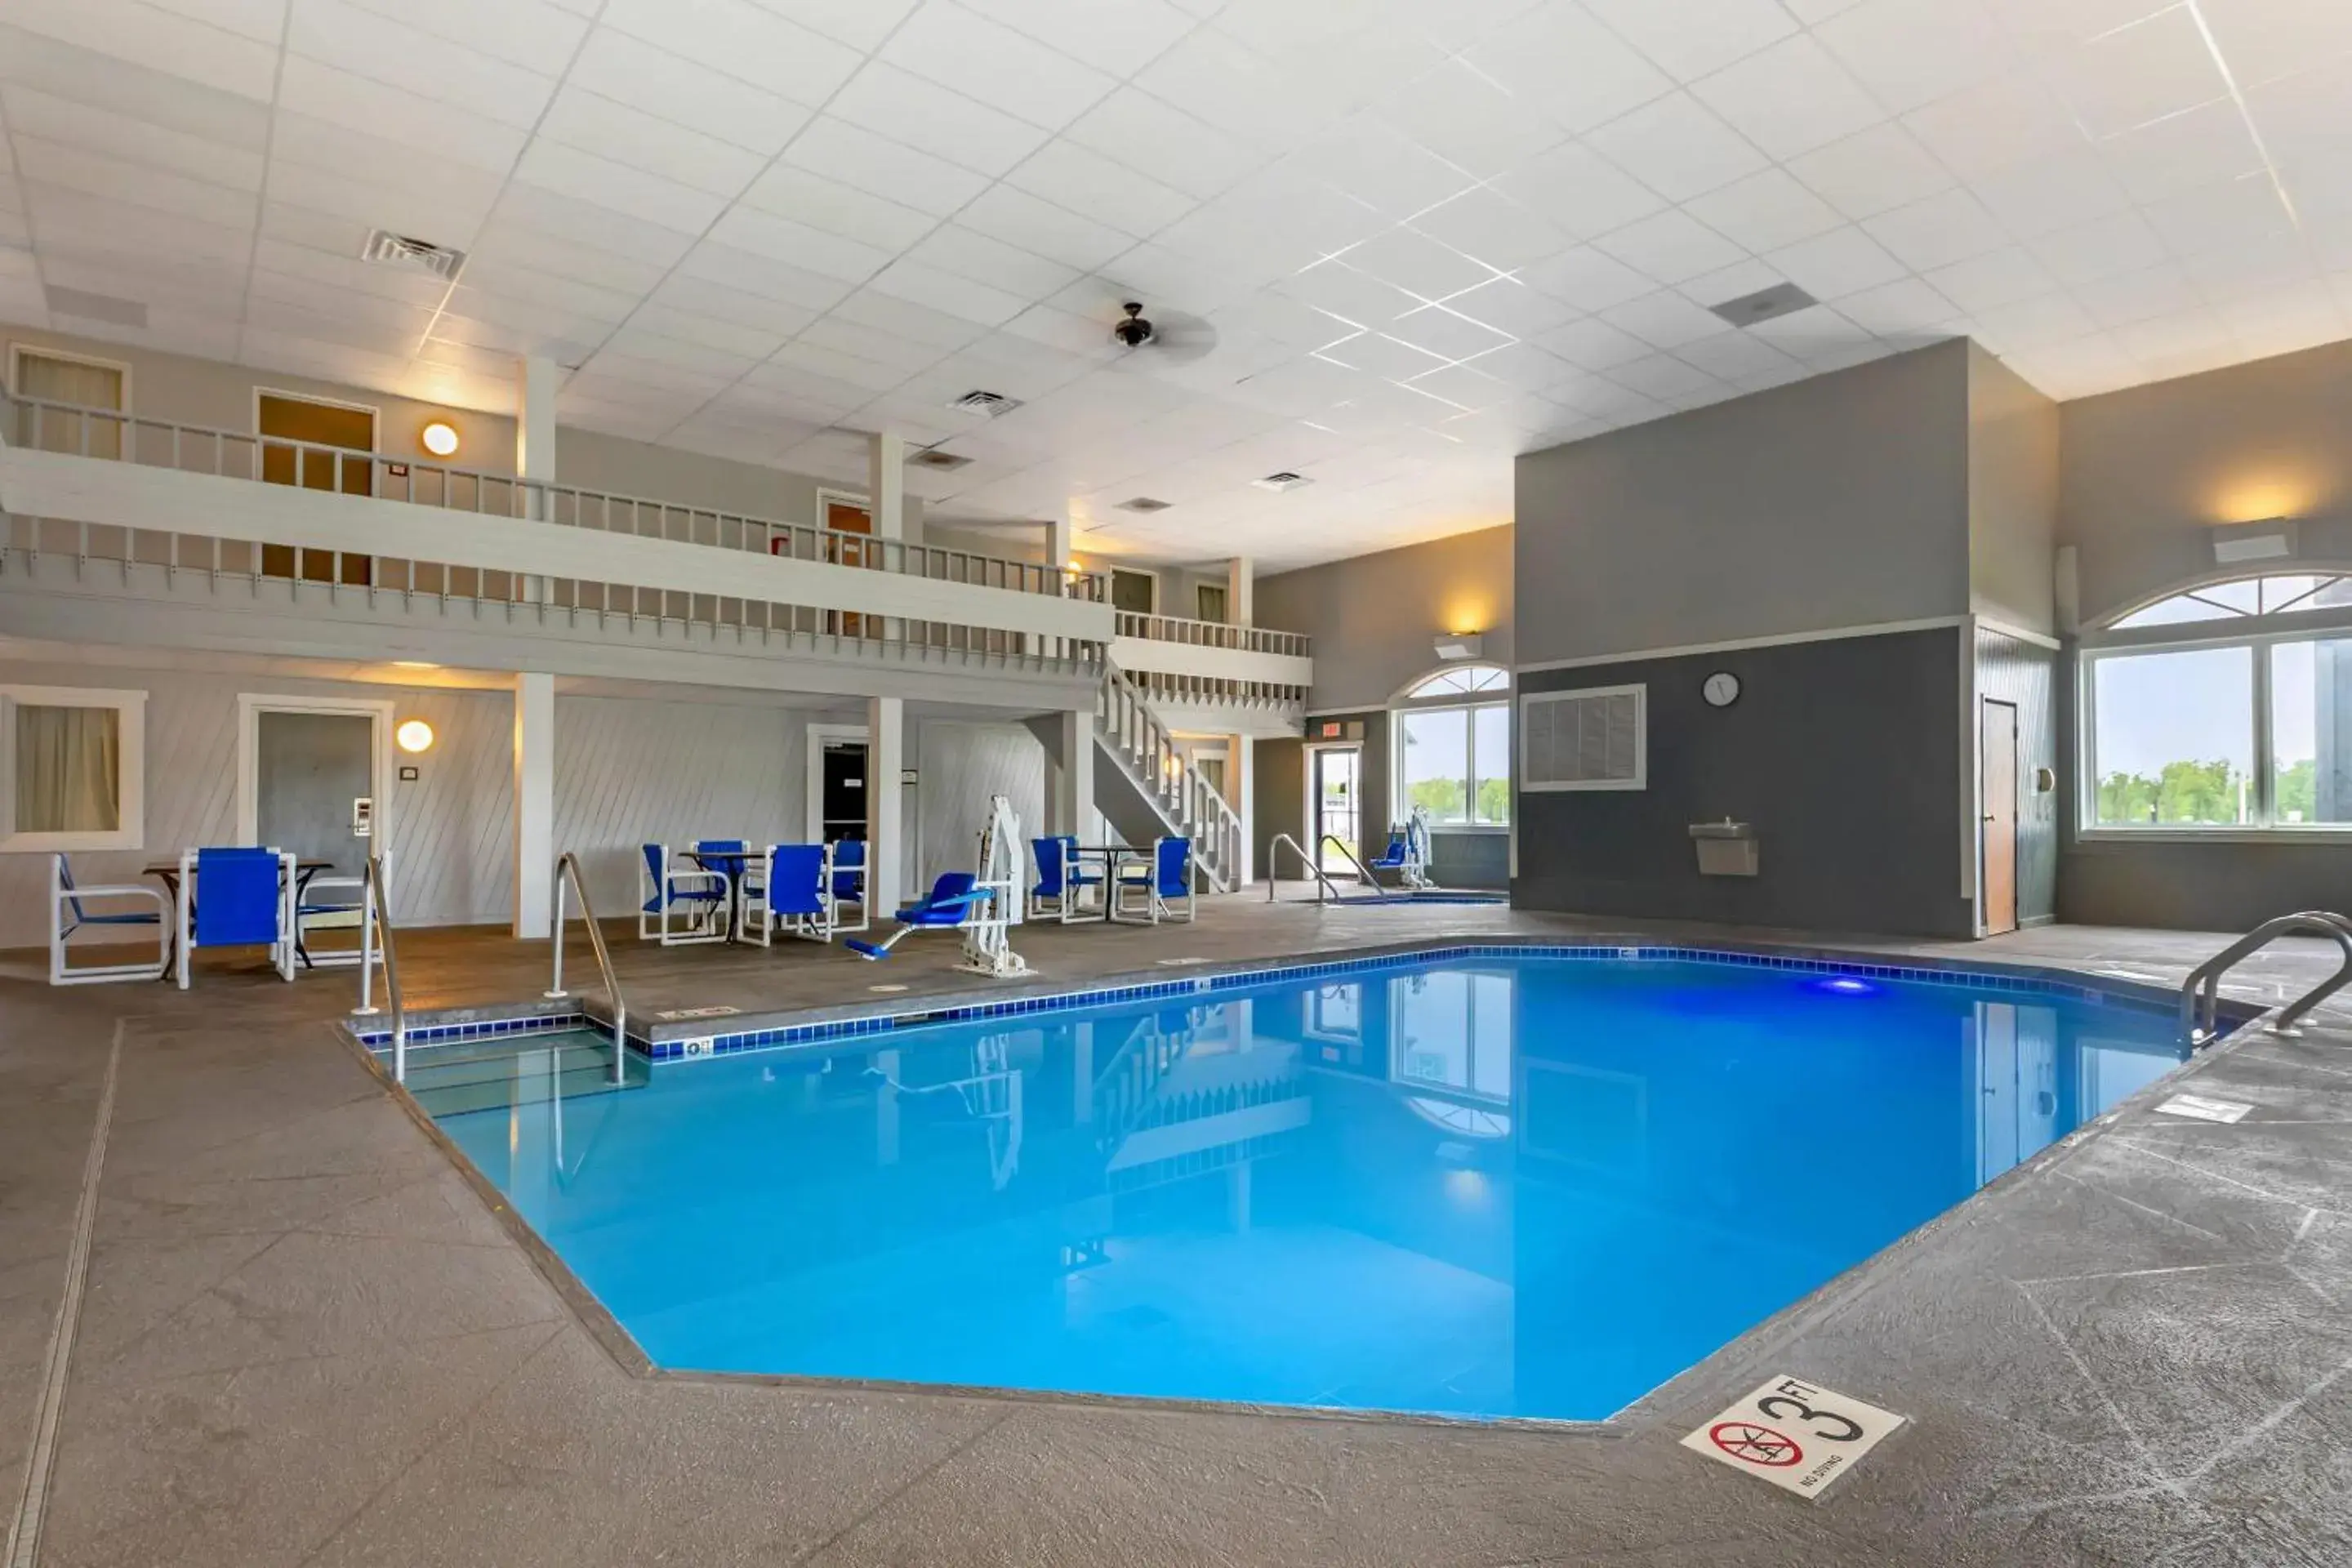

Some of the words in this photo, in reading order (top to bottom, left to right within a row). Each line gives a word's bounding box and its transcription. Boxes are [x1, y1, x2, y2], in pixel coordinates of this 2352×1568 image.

[1776, 1379, 1819, 1401] FT
[1757, 1396, 1864, 1441] 3
[1799, 1476, 1818, 1487] NO
[1812, 1454, 1843, 1477] DIVING
